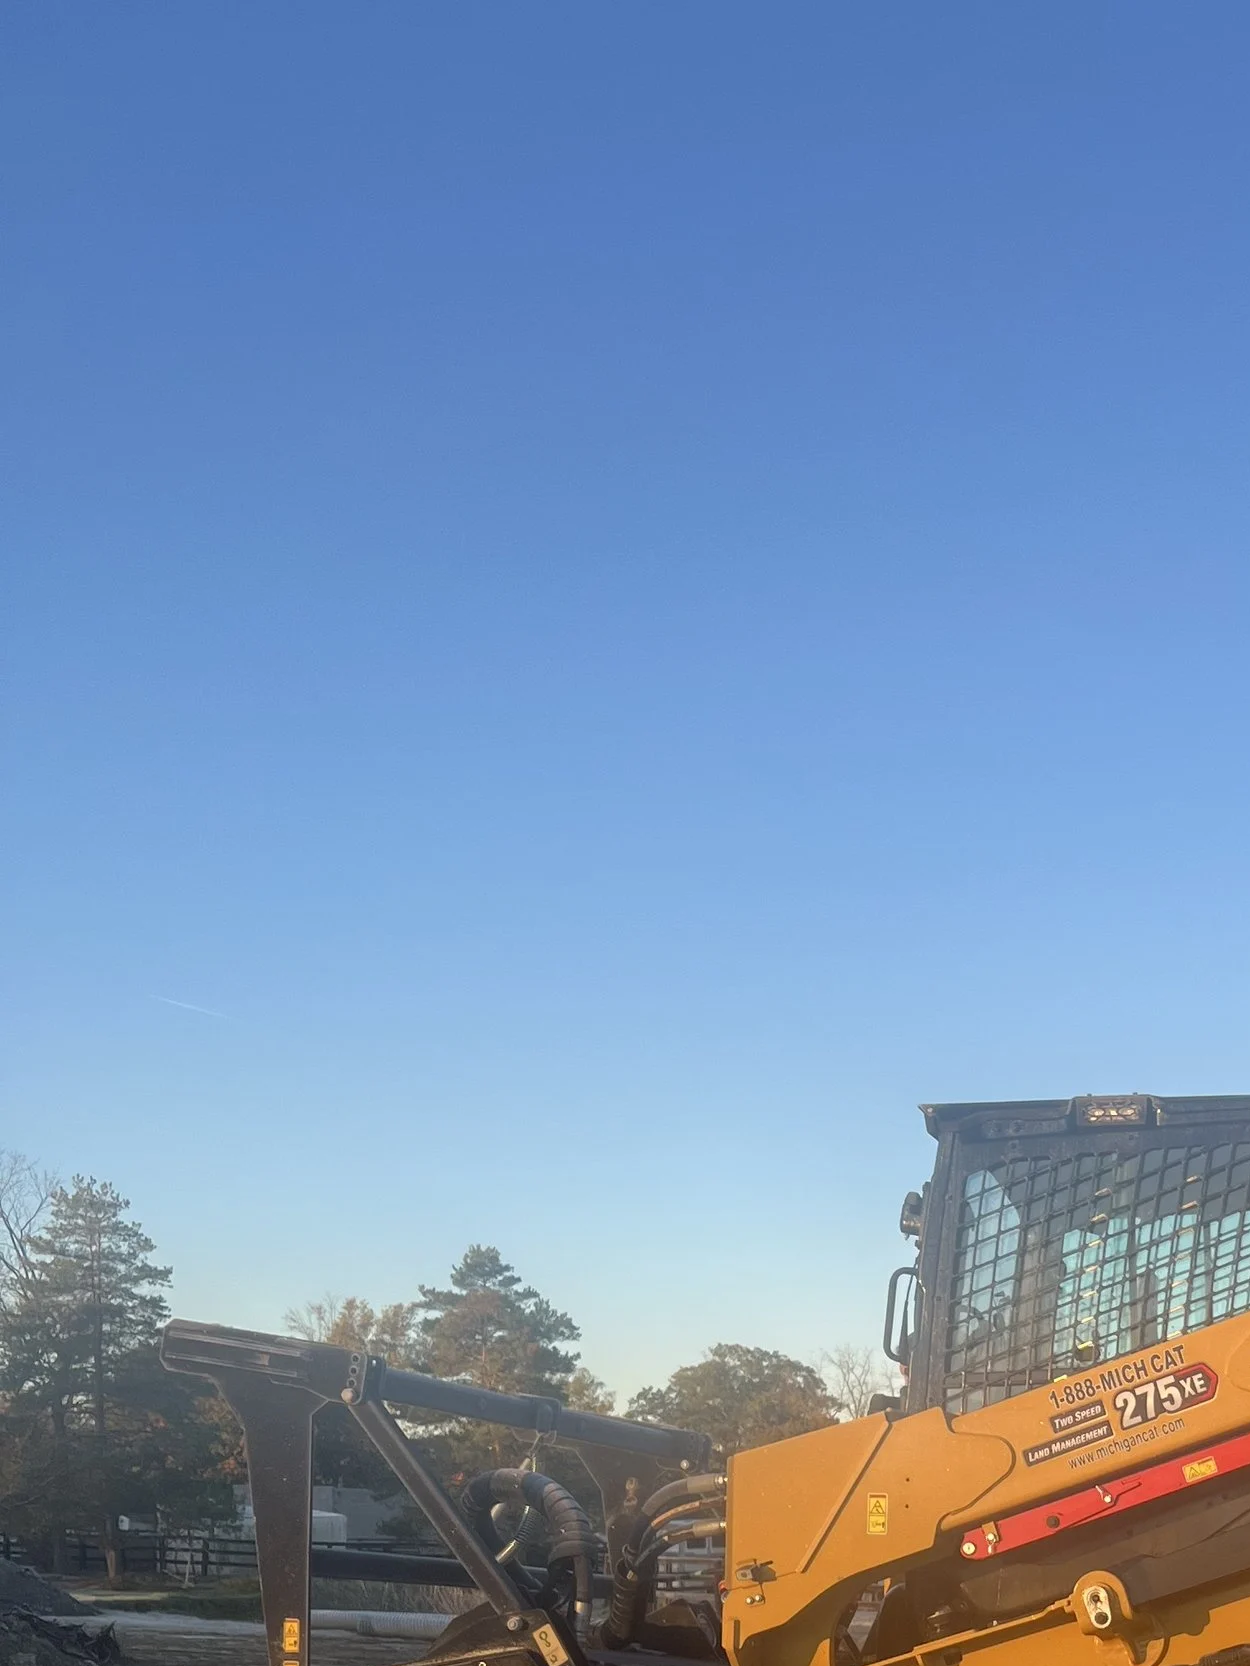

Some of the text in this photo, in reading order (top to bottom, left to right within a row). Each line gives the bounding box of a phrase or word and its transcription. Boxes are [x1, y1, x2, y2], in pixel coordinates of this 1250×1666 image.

[1050, 1345, 1186, 1410] 1-888-MICH CAT
[1115, 1372, 1208, 1430] 275XE
[1067, 1417, 1186, 1470] www.michigancat.com
